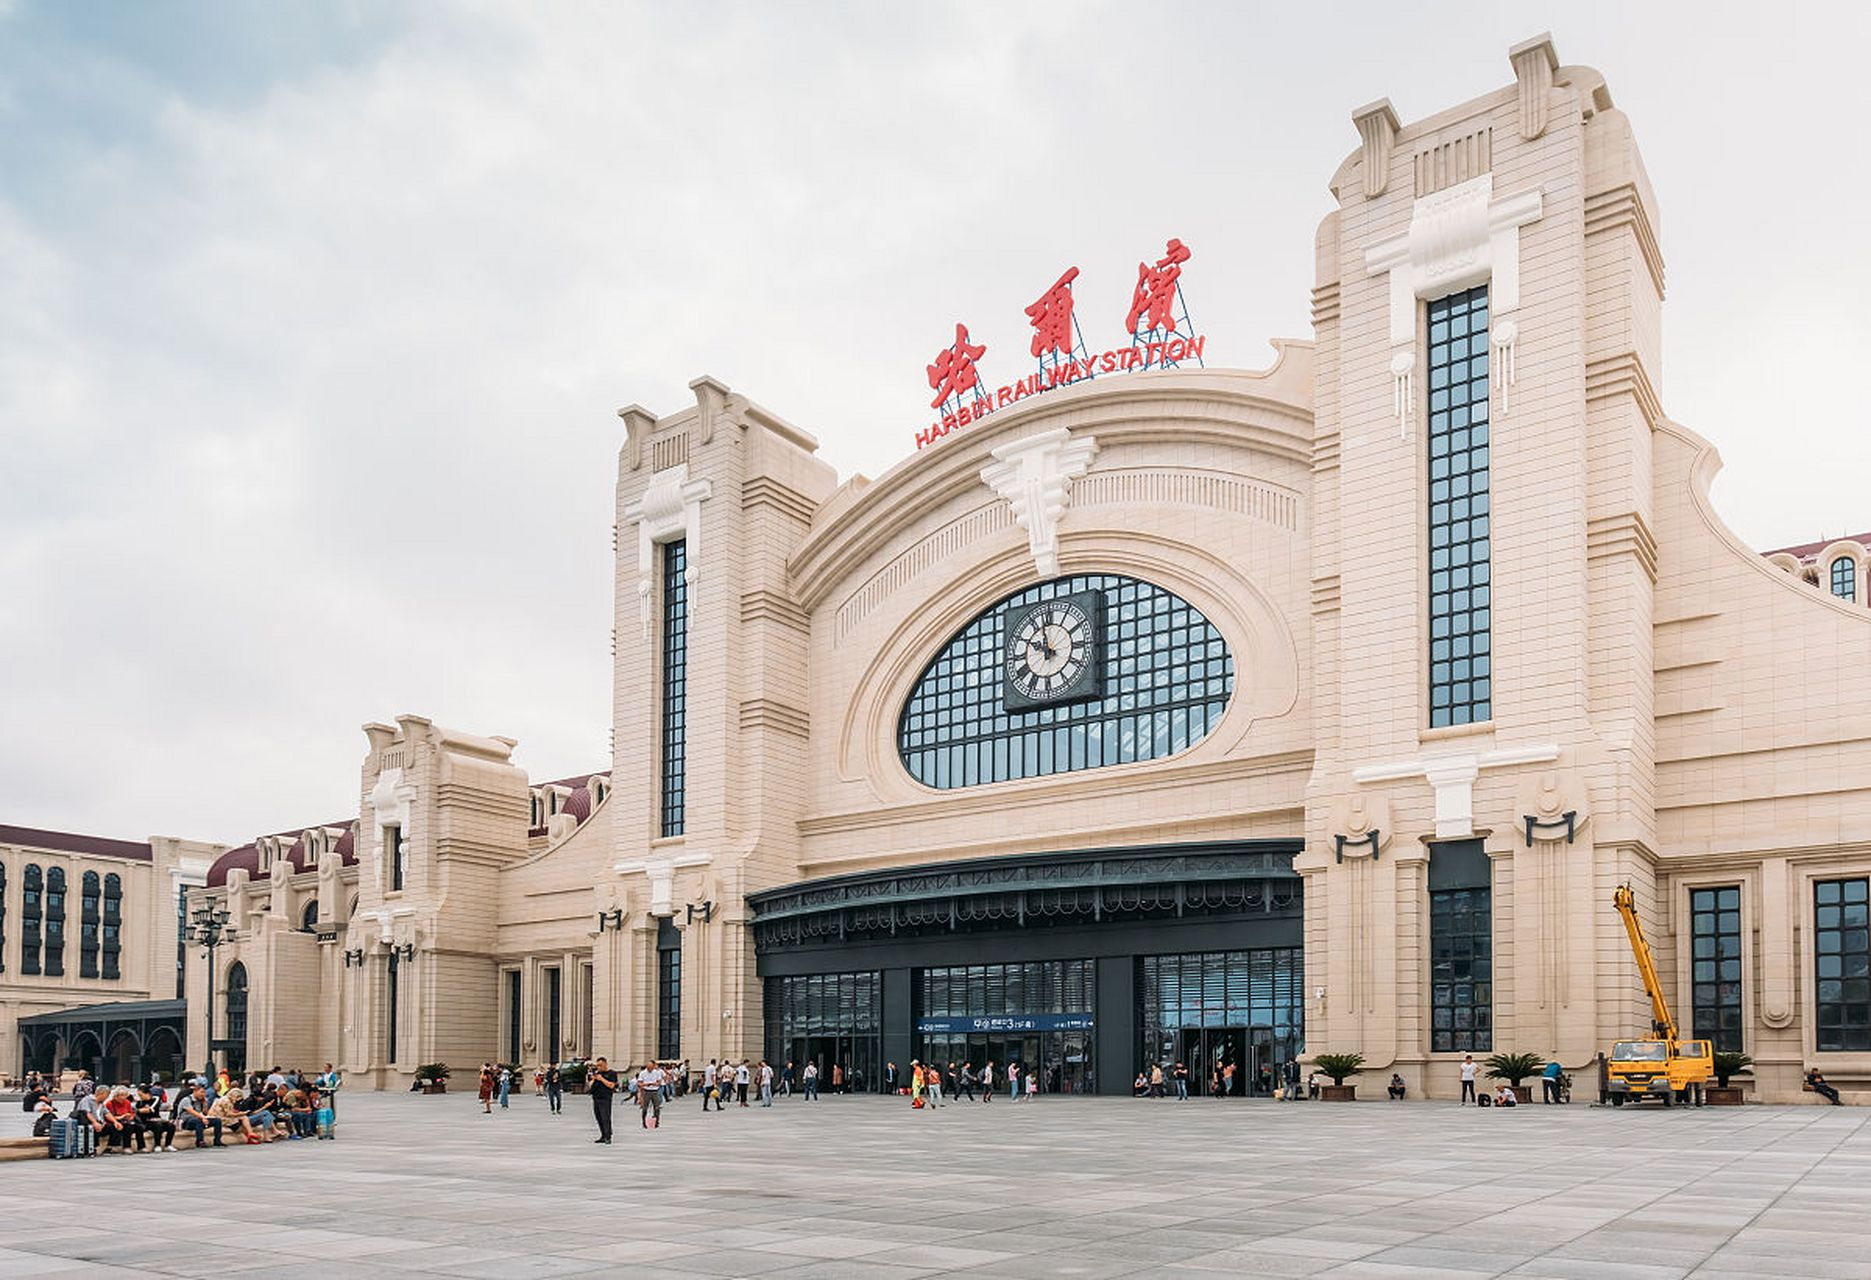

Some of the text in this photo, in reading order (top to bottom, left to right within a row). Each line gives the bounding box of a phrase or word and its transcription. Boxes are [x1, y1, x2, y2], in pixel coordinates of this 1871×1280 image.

[914, 335, 1206, 449] HARBIN RAILWAY STATION
